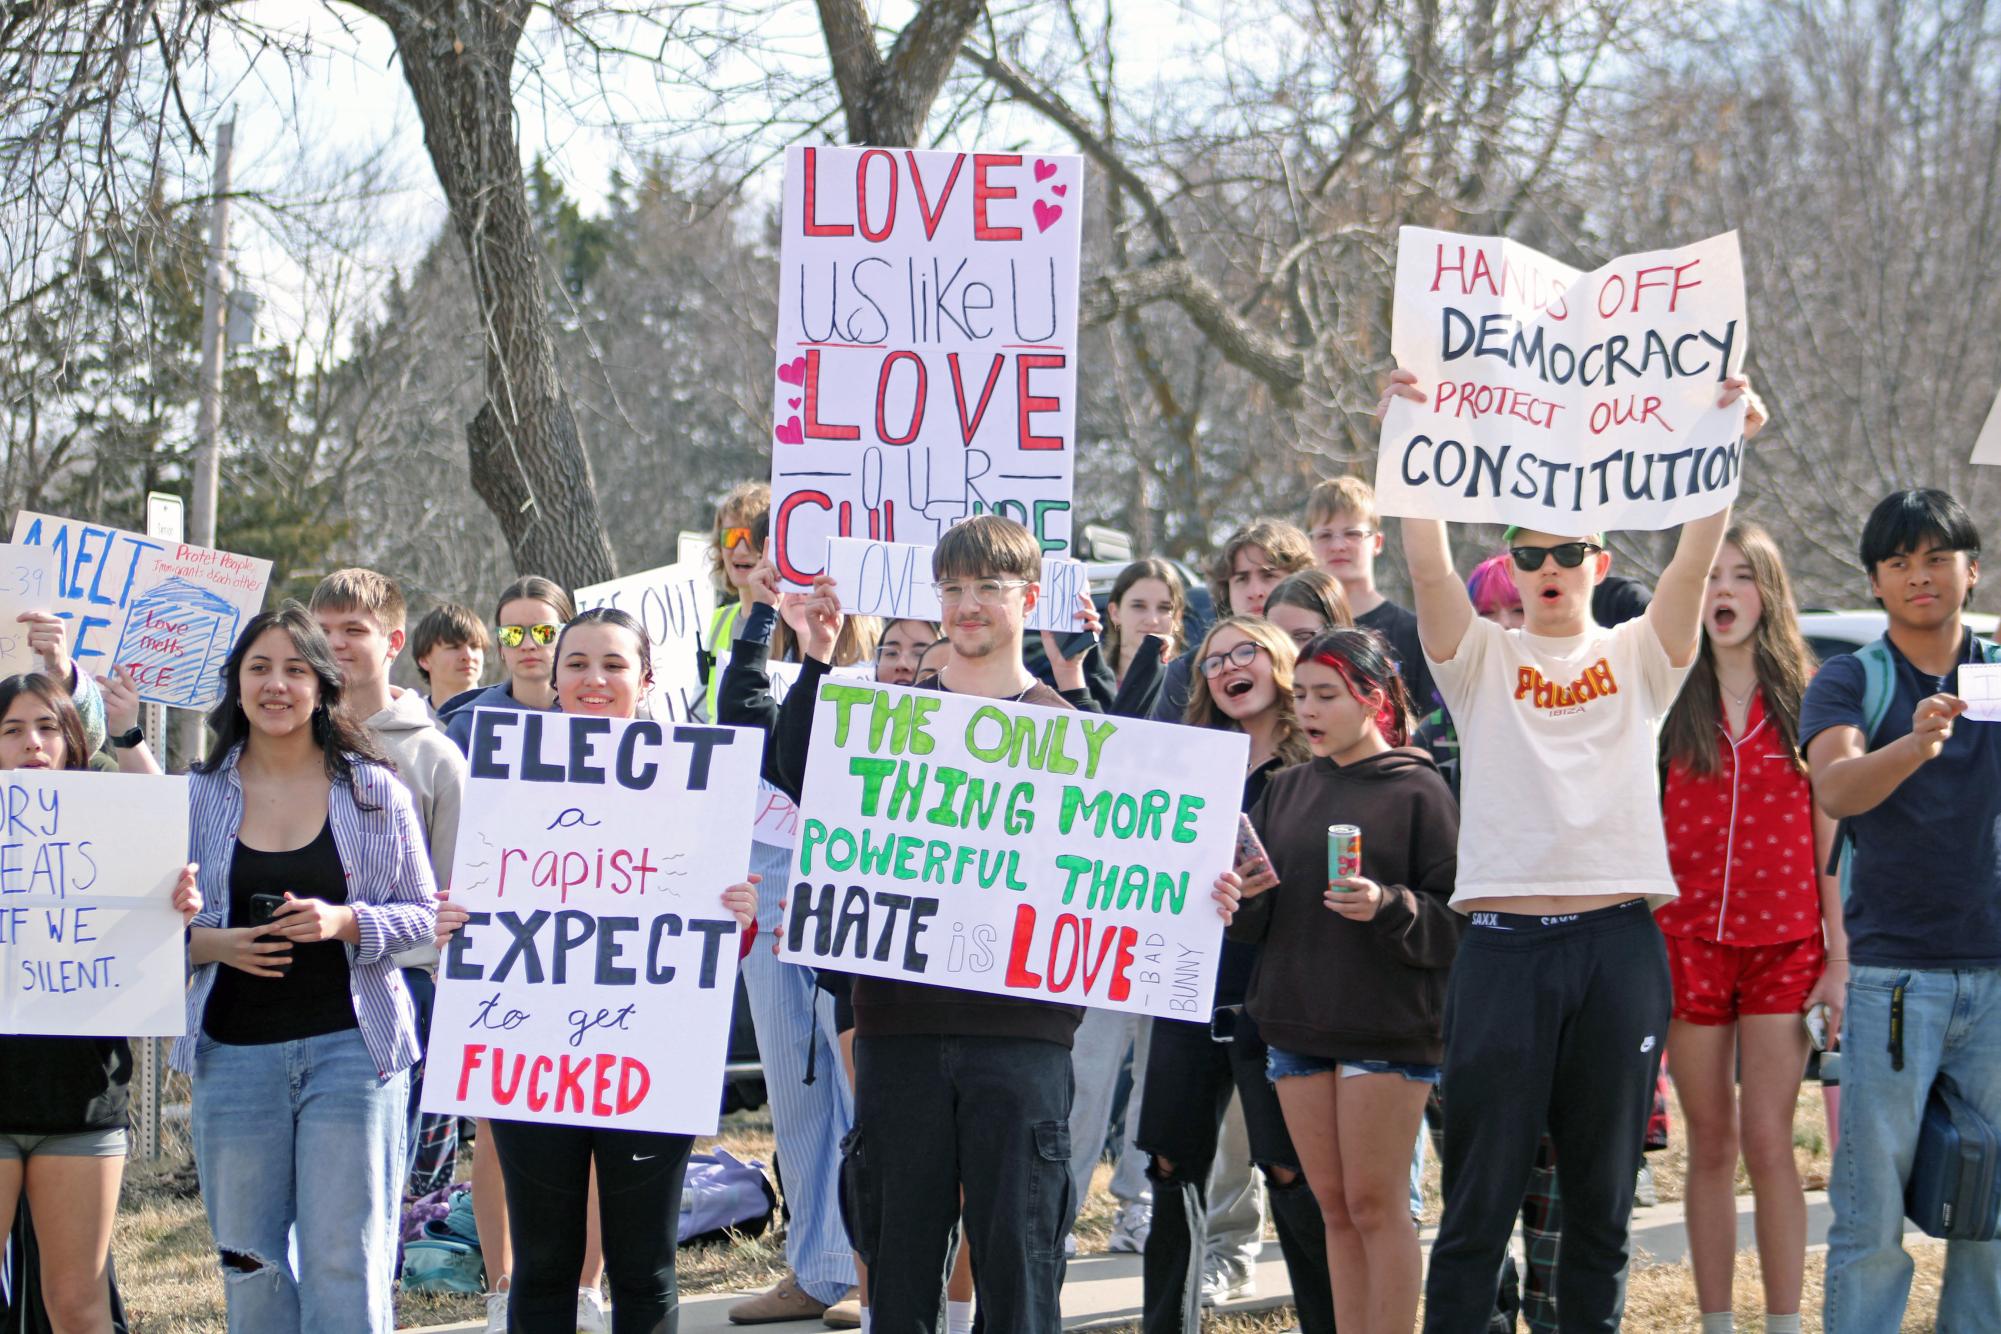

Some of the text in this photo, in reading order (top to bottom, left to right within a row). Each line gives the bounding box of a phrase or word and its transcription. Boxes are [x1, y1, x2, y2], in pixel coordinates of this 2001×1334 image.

[803, 147, 1023, 243] LOVE
[1010, 257, 1056, 342] U
[1430, 244, 1703, 322] HANDS OFF
[1442, 306, 1738, 387] DEMOCRACY
[804, 349, 1067, 451] LOVE
[1433, 381, 1675, 435] PROTECT OUR
[862, 446, 992, 512] OUR
[1401, 434, 1744, 512] CONSTITUTION
[826, 540, 928, 618] LOVE
[145, 609, 190, 636] Love
[126, 662, 175, 688] ICE
[820, 683, 941, 756] THE
[964, 705, 1118, 780] ONLY
[1548, 706, 1587, 717] IBIZA
[470, 710, 736, 791] ELECT
[0, 784, 59, 838] RY
[546, 807, 602, 831] a
[849, 756, 1206, 844] THING MORE
[0, 841, 97, 900] EATS
[497, 847, 658, 904] rapist
[799, 818, 1191, 916] POWERFUL THAN
[46, 906, 98, 944] WE
[445, 909, 737, 989] EXPECT
[787, 881, 1138, 1002] HATE is LOVE
[1471, 912, 1499, 926] SAXX
[21, 956, 120, 994] SILENT.
[1168, 942, 1206, 1013] BUNNY
[469, 992, 636, 1048] to get
[455, 1043, 651, 1117] FUCKED
